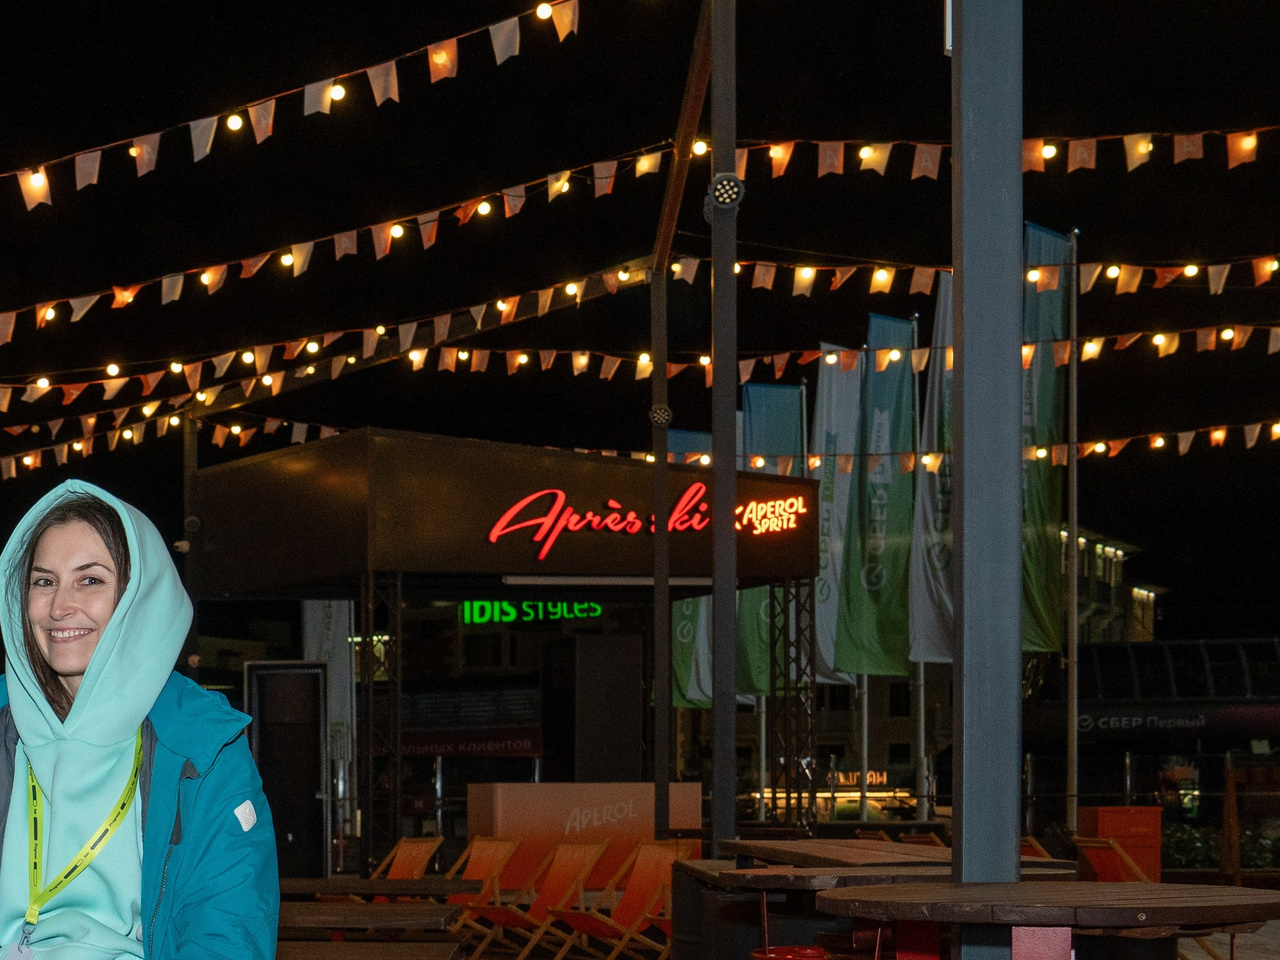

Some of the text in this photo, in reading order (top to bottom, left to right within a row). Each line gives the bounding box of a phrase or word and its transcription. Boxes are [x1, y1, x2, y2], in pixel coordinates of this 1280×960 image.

[487, 481, 711, 562] Après ki
[743, 496, 807, 526] APEROL
[564, 799, 638, 836] APEROL
